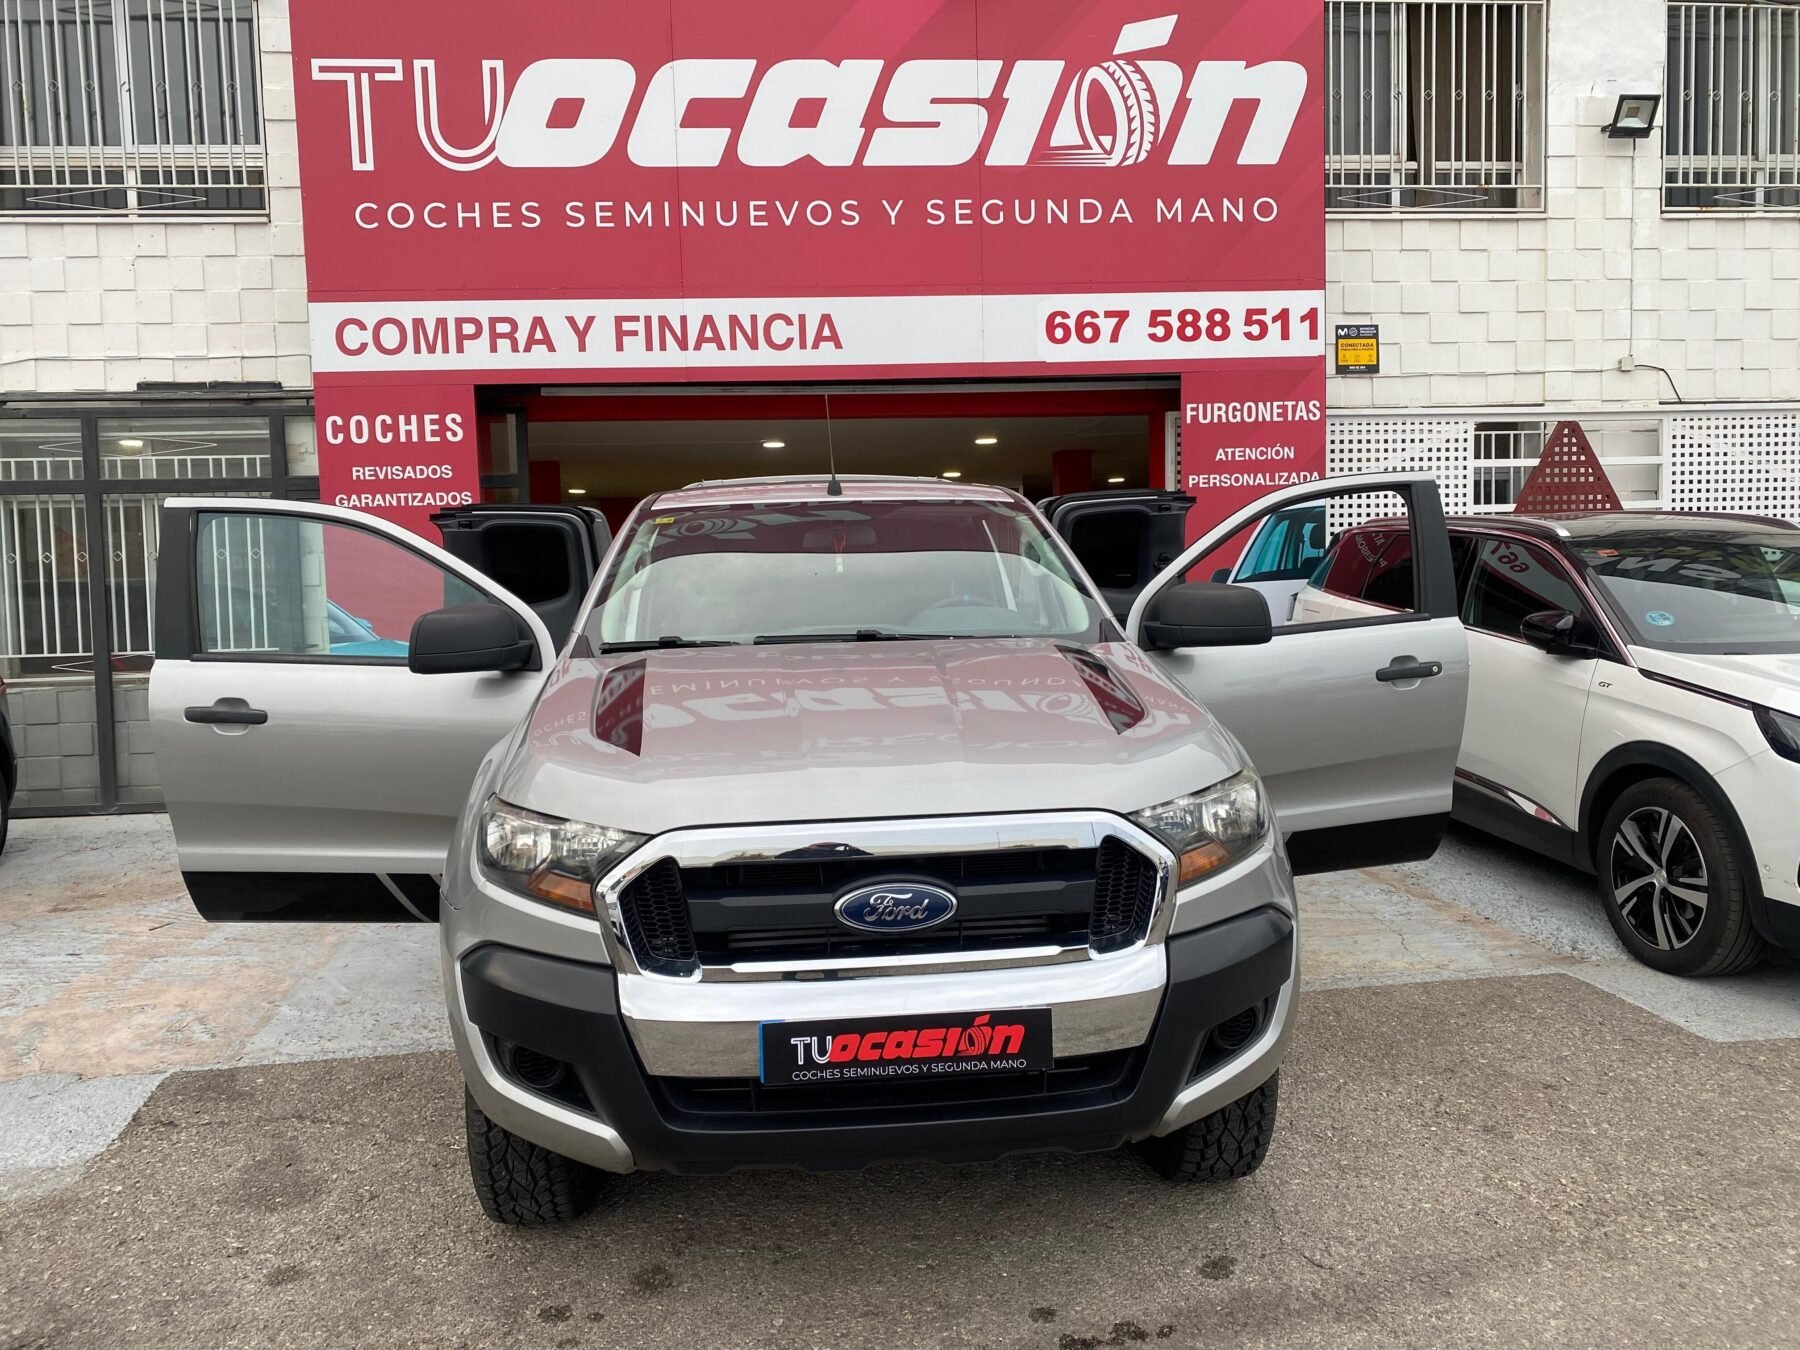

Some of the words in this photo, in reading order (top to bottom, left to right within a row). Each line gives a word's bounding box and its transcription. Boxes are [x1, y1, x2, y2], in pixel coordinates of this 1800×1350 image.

[354, 201, 543, 230] COCHES
[565, 199, 860, 228] SEMINUEVOS
[881, 200, 904, 225] Y
[926, 198, 1134, 226] SEGUNDA
[1156, 196, 1279, 224] MANO
[334, 315, 557, 357] COMPRA
[565, 315, 596, 352] Y
[614, 312, 843, 352] FINANCIA
[1044, 310, 1130, 345] 667
[1147, 308, 1231, 343] 588
[1243, 307, 1319, 341] 511
[1186, 400, 1321, 424] FURGONETAS
[325, 413, 464, 444] COCHES
[1215, 443, 1295, 461] ATENCIÓN
[352, 464, 453, 480] REVISADOS
[1188, 471, 1320, 488] PERSONALIZADA
[335, 491, 473, 508] GARANTIZADOS
[1598, 681, 1613, 689] GT
[863, 893, 930, 922] Ford
[792, 1069, 841, 1081] COCHES
[843, 1064, 920, 1078] SEMINUEVOS
[921, 1063, 930, 1073] Y
[931, 1060, 989, 1073] SEGUNDA
[990, 1058, 1027, 1070] MANO
